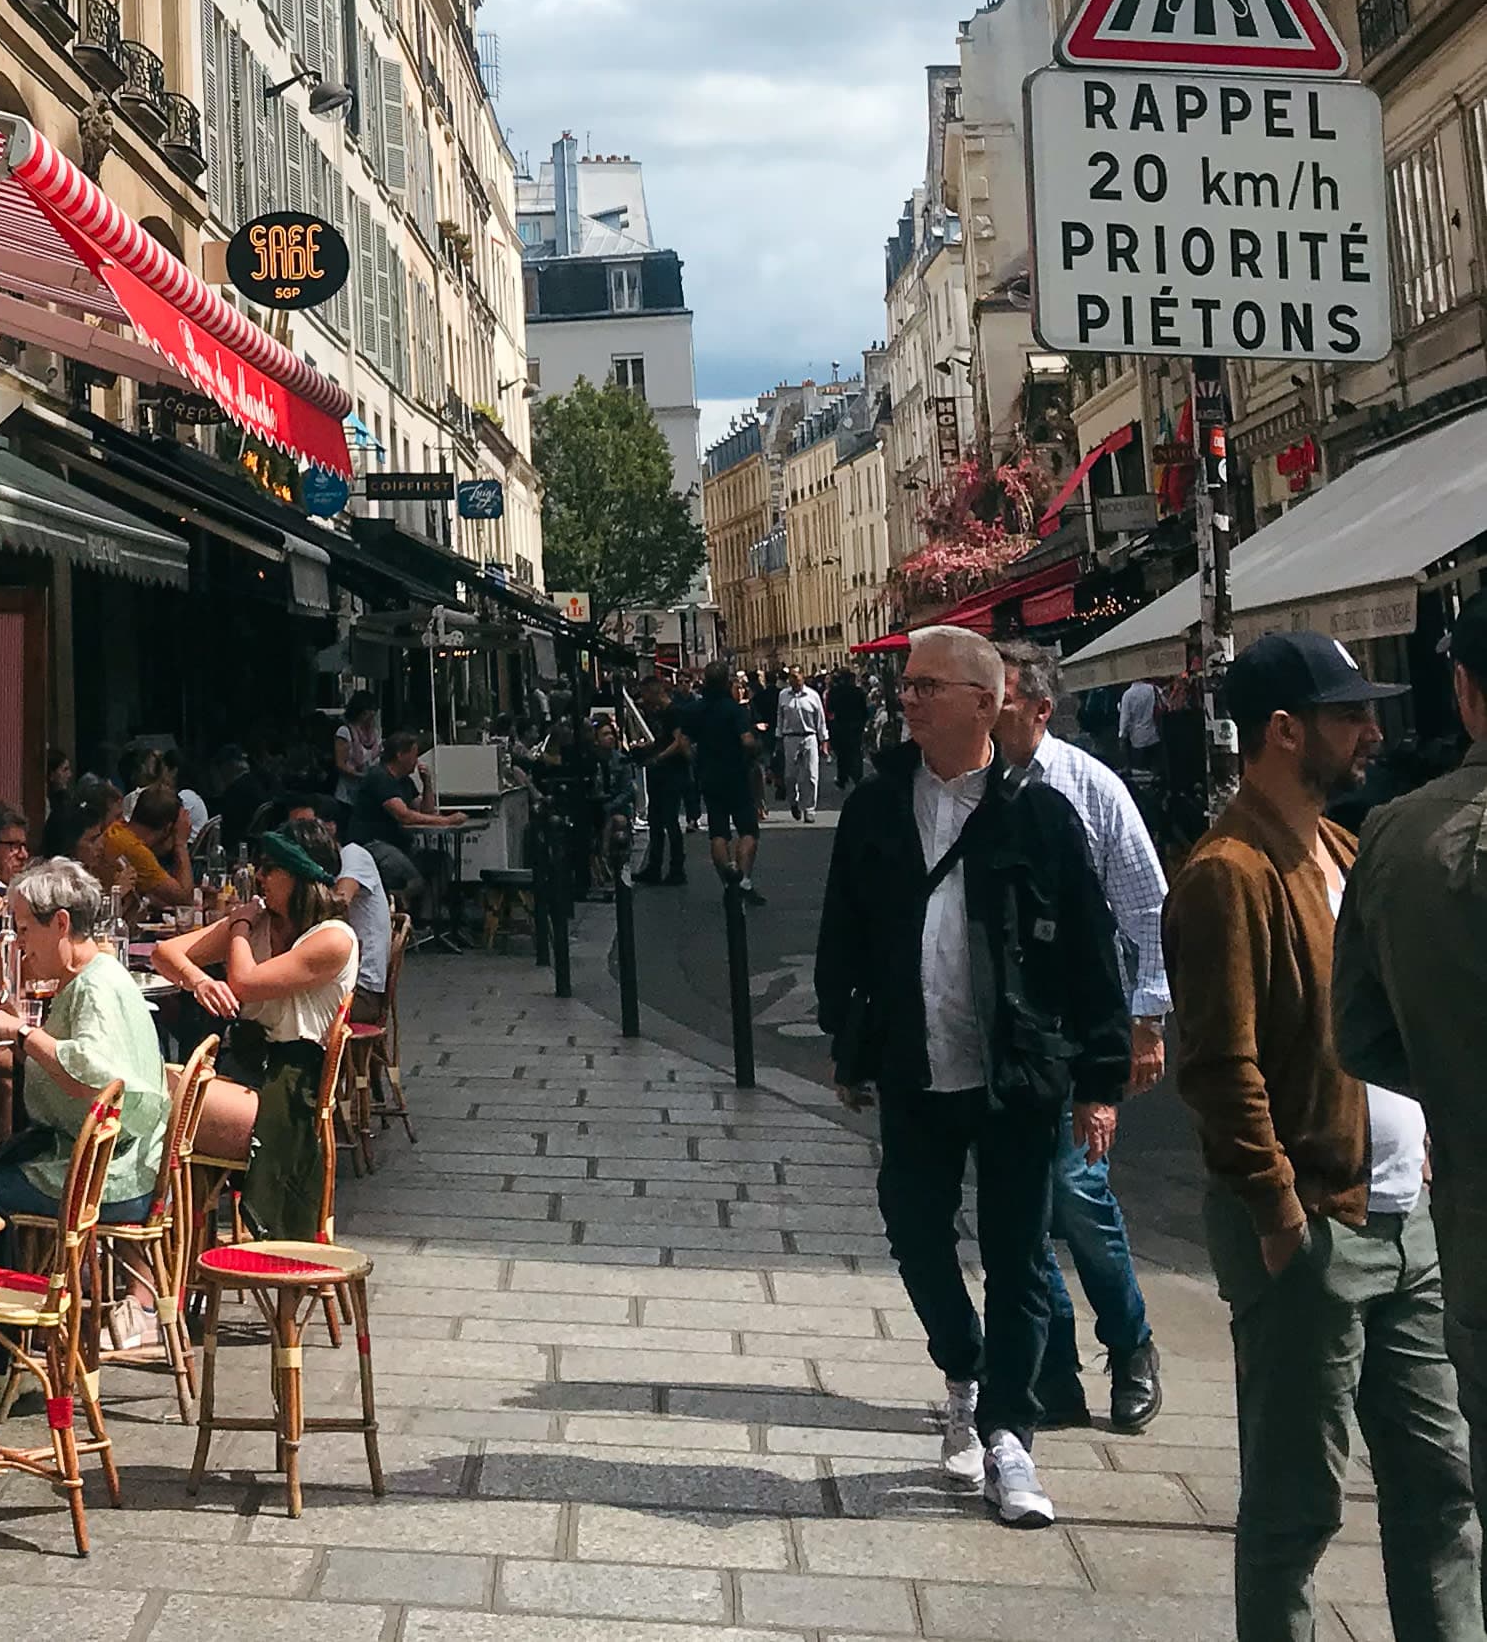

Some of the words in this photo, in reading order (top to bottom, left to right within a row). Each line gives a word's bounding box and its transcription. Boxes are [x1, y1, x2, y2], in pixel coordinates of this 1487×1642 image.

[1082, 79, 1338, 141] RAPPEL
[1087, 150, 1169, 203] 20
[1201, 155, 1341, 212] km/h
[1060, 219, 1372, 284] PRIORITÉ
[274, 286, 301, 300] SGP
[1076, 284, 1362, 355] PIÉTONS
[163, 396, 224, 423] CREPE
